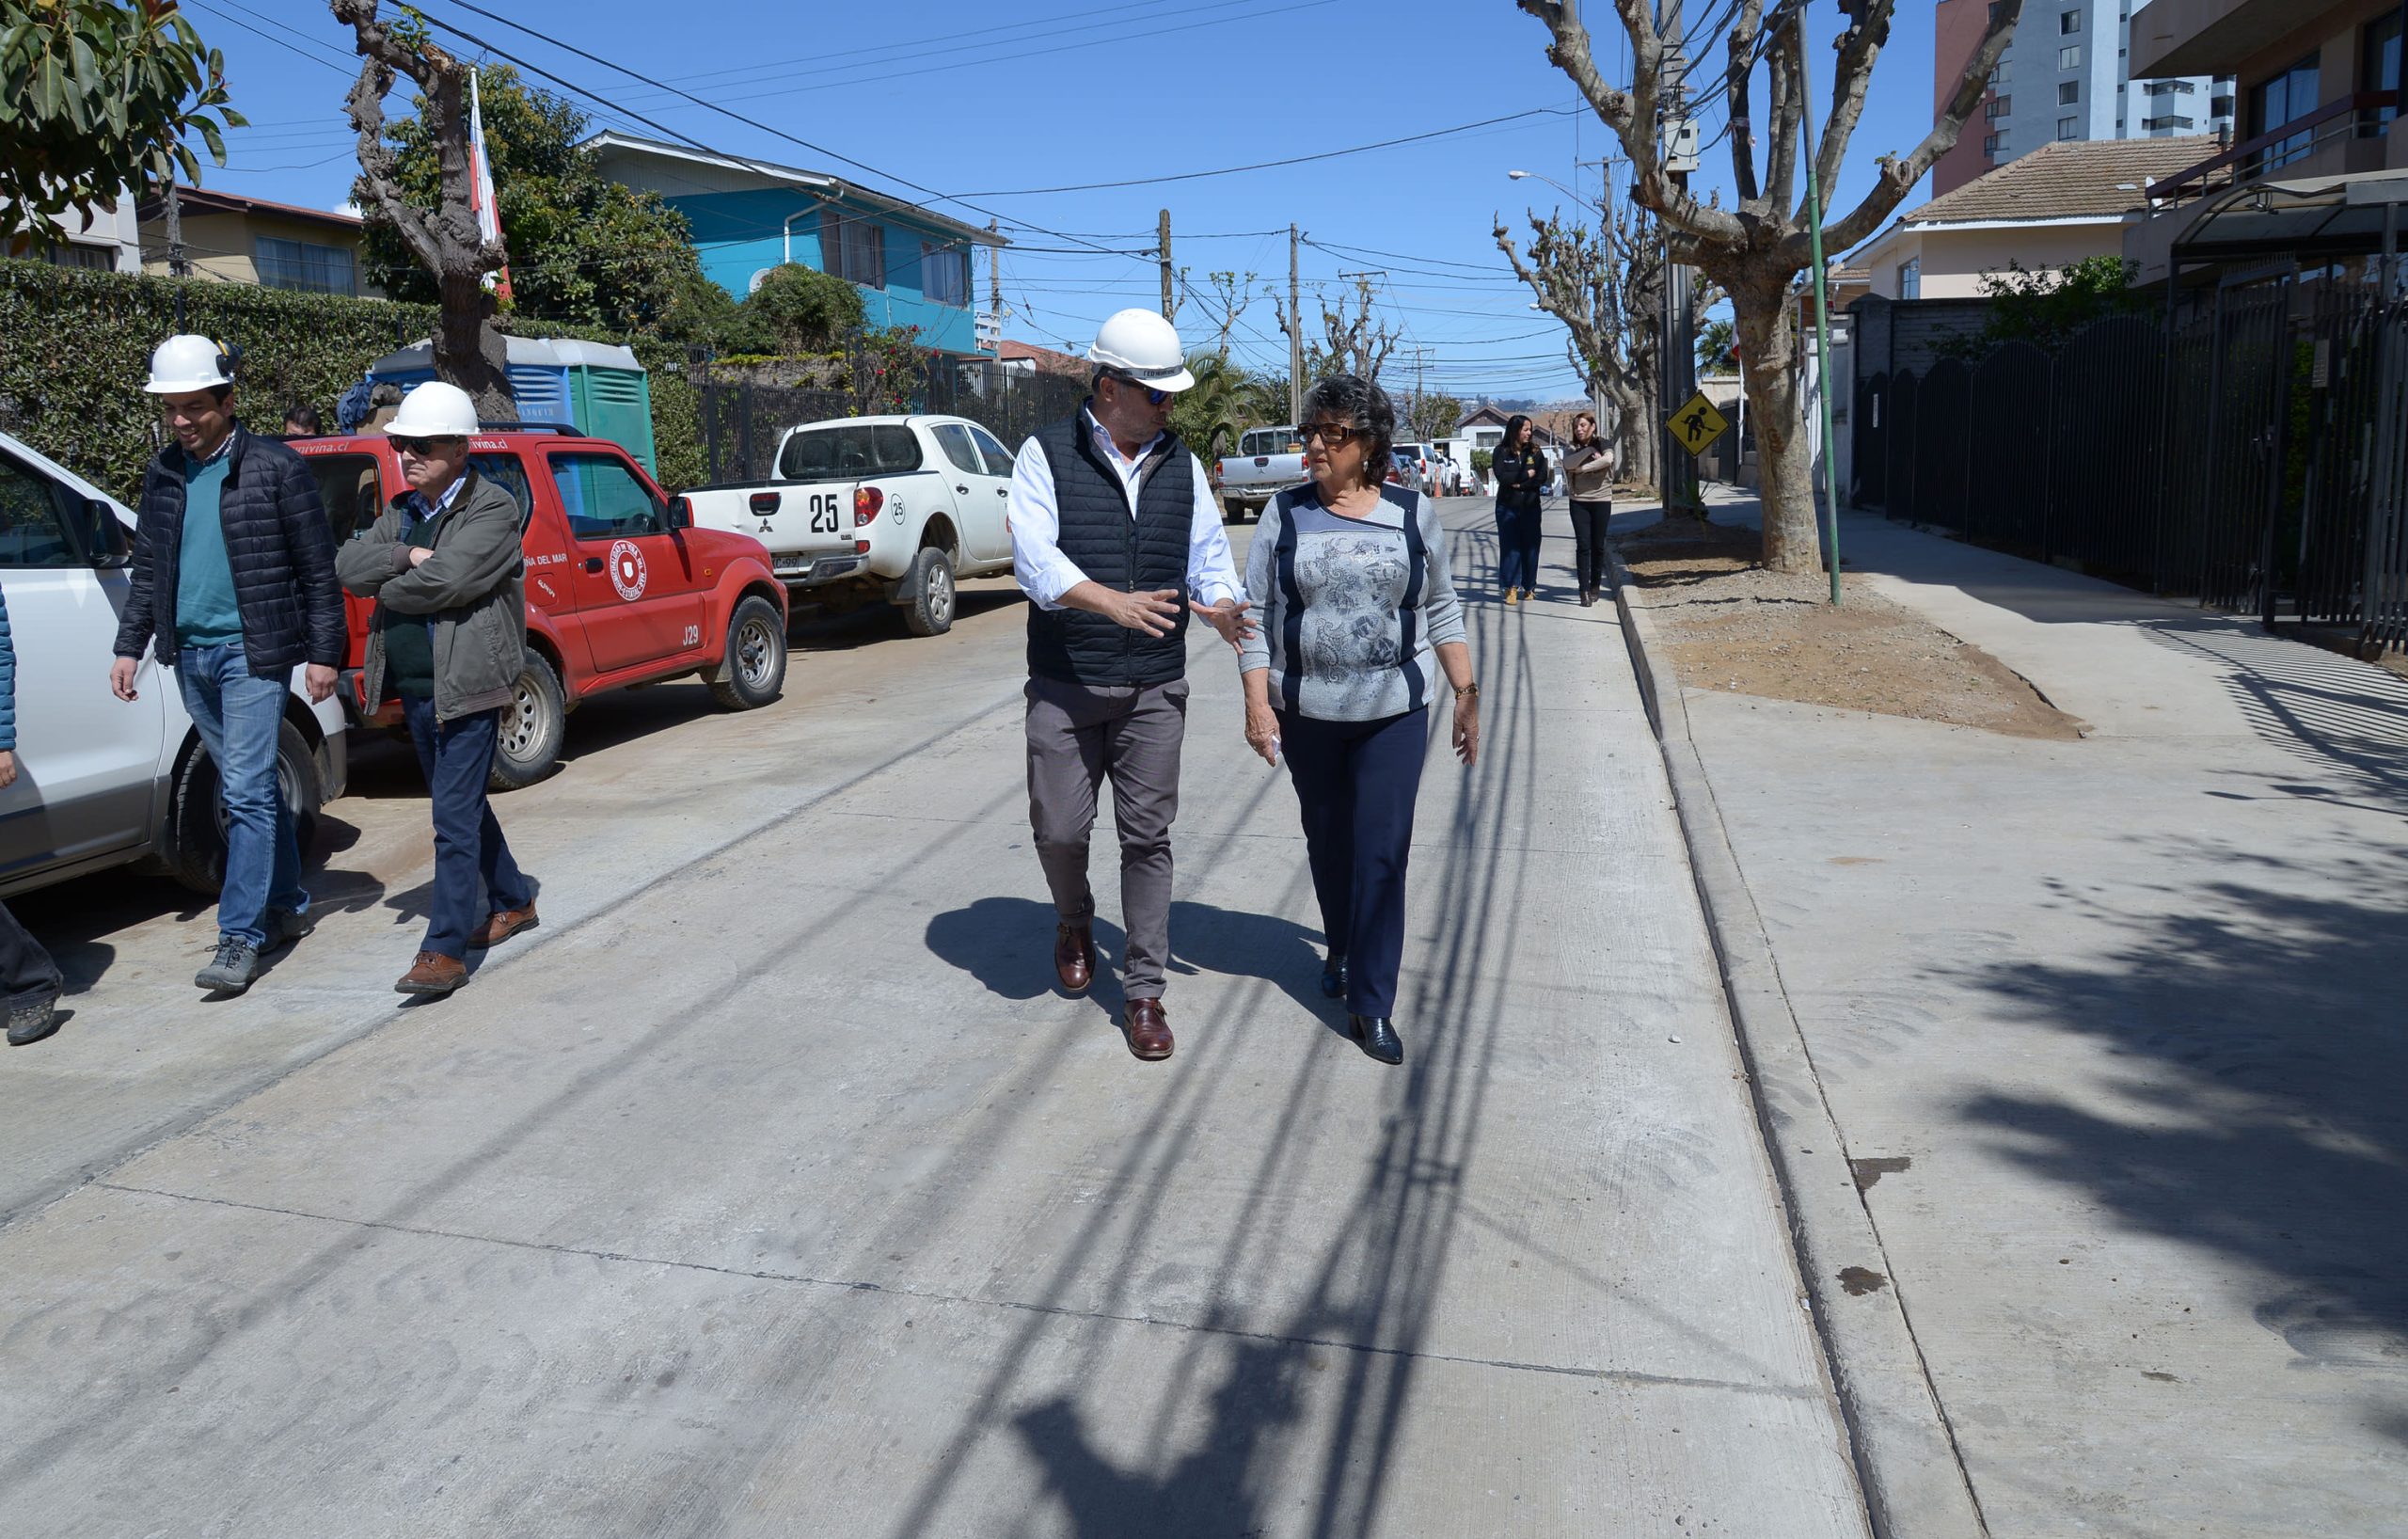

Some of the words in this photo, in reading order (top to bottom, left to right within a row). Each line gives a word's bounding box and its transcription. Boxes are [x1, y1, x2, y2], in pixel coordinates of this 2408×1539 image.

[810, 494, 839, 533] 25
[893, 502, 904, 516] 25
[537, 555, 551, 565] DEL
[552, 553, 568, 563] MAR
[682, 624, 699, 647] J29
